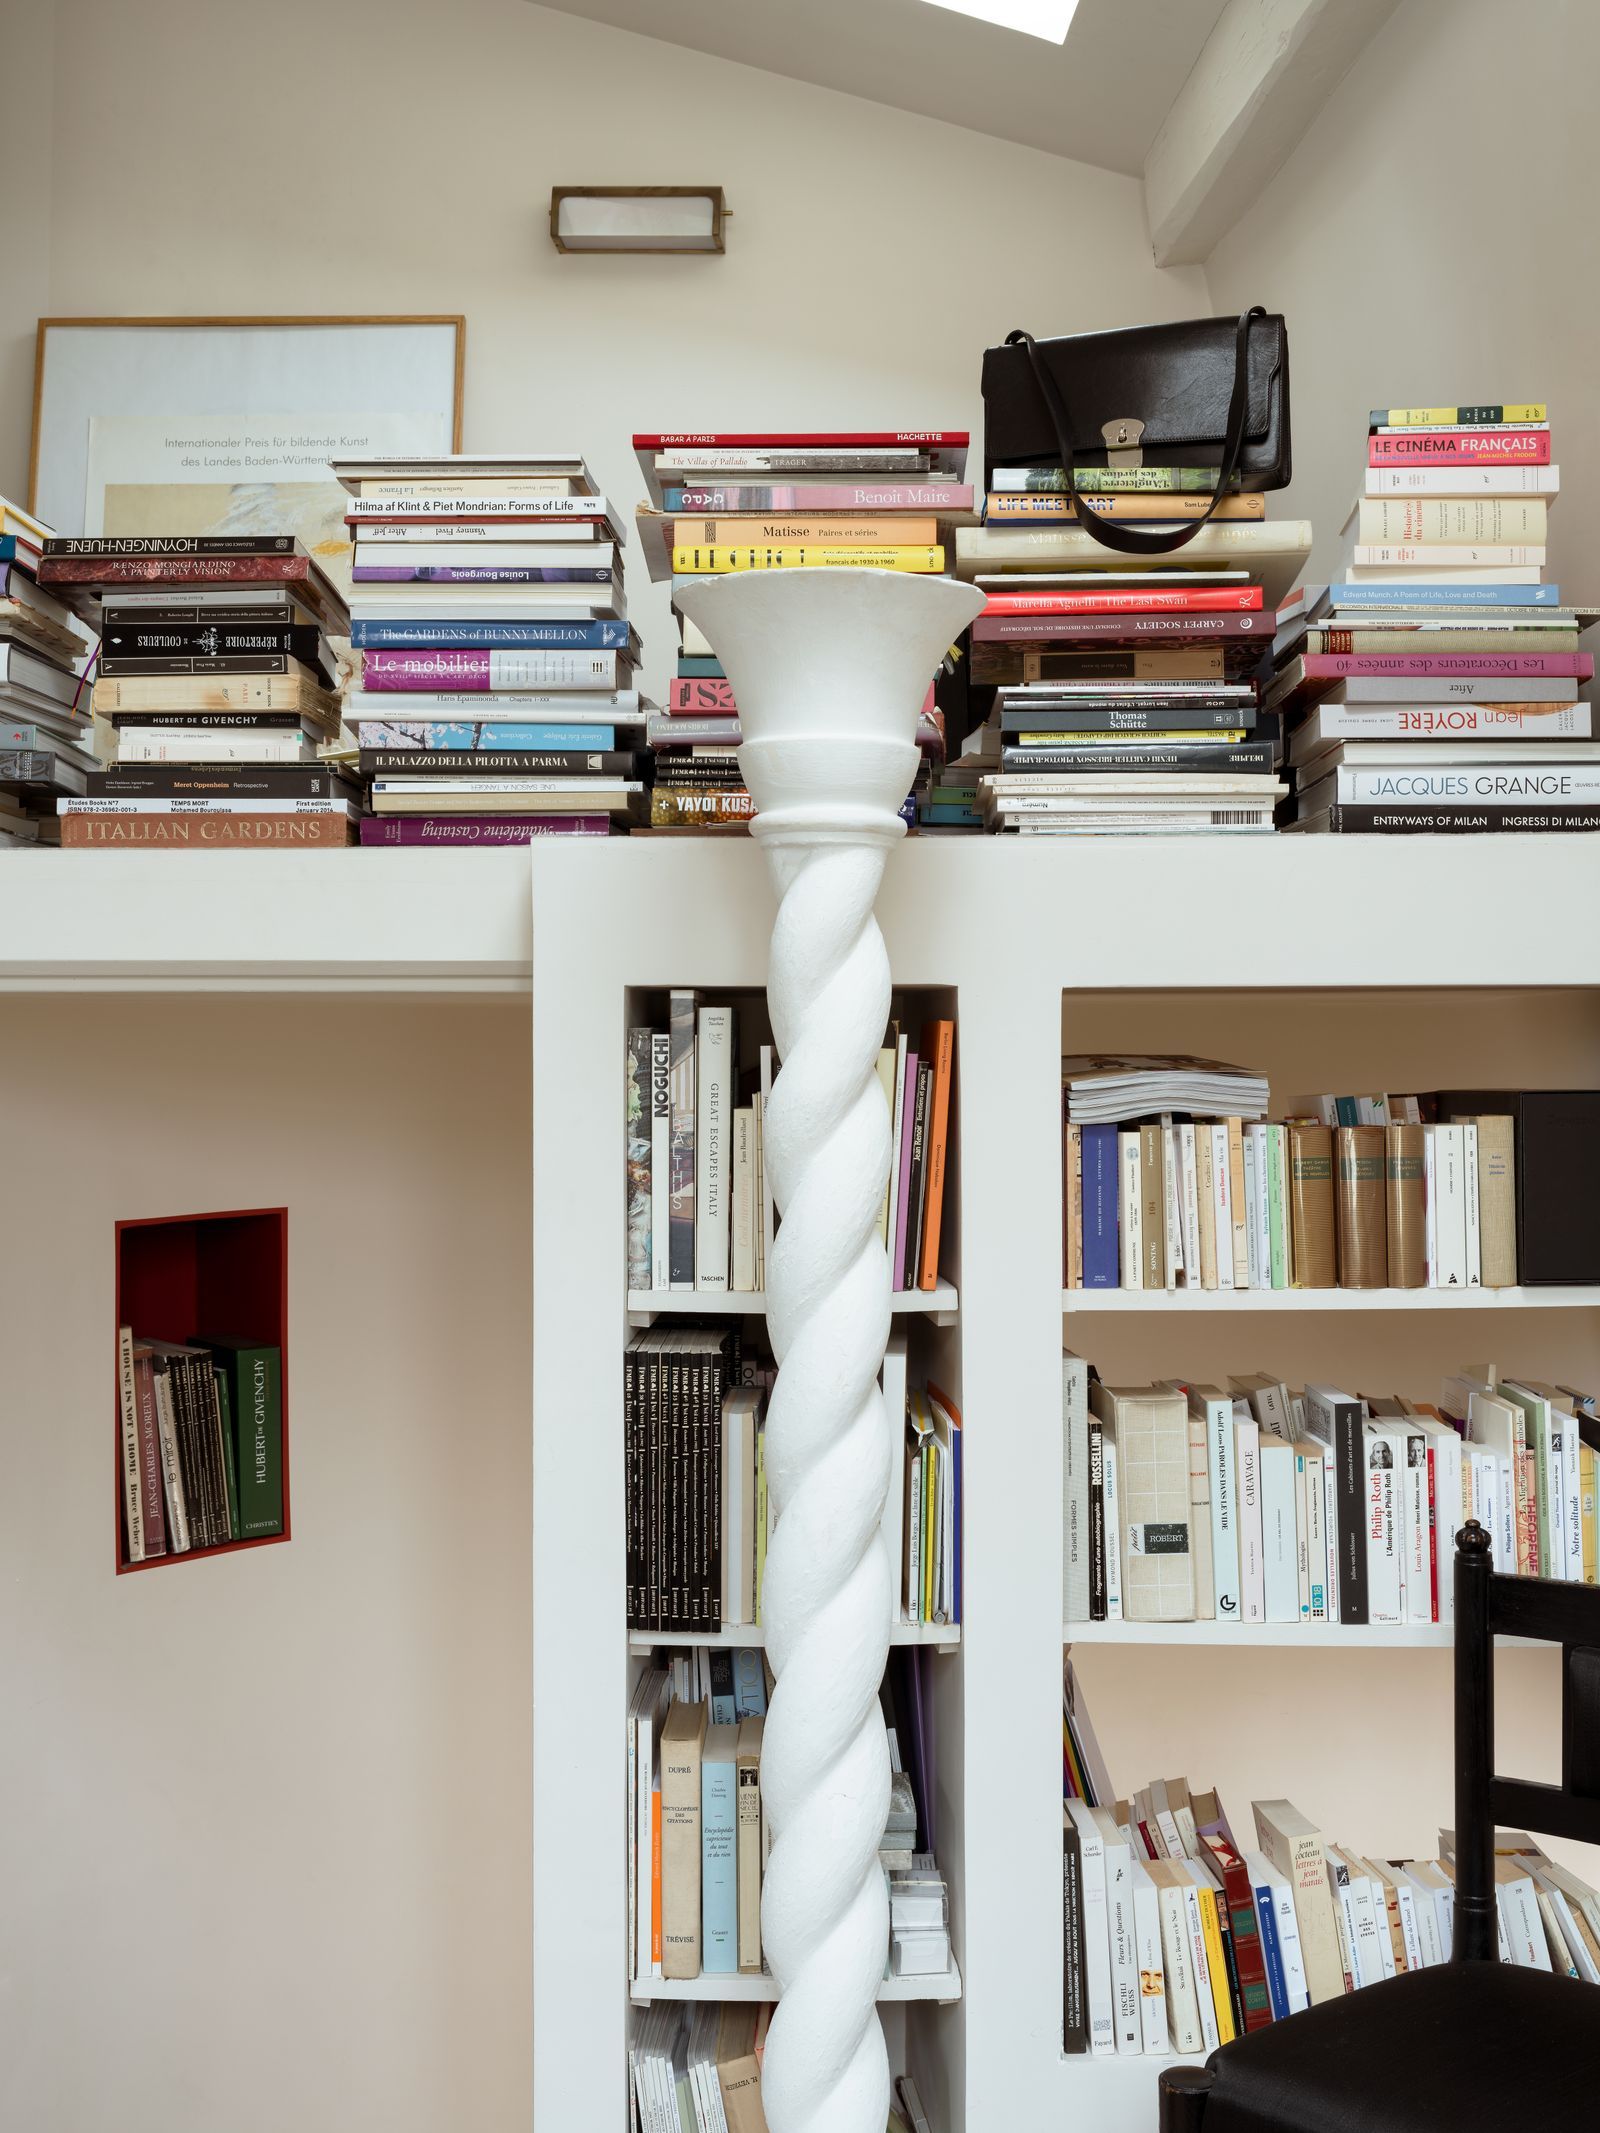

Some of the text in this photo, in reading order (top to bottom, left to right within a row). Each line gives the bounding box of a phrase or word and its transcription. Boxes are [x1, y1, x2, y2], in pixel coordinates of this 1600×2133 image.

[165, 435, 369, 449] Internationaler Preis für bildende Kunst
[660, 434, 716, 444] BABAR PARIS
[896, 432, 943, 442] HACHETTE
[1375, 436, 1537, 454] LE CINÉMA FRANÇAIS
[181, 456, 241, 467] des Landes
[1100, 469, 1138, 478] jardins
[854, 489, 951, 503] Benoît Maire
[353, 499, 575, 512] Hilma af Klint & Piet Mondrian: Forms of Life
[997, 497, 1116, 511] LIFE ART
[1184, 500, 1196, 509] Sam
[388, 527, 454, 537] Fivel After
[763, 525, 879, 539] Matisse Paires et séries
[65, 538, 199, 554] HOYNINGEN-HUENE
[111, 559, 237, 571] RENZO MONGIARDINO
[826, 558, 896, 567] français de 1930 1960
[129, 566, 232, 577] PAINTERLY VISION
[450, 569, 530, 581] Louise Bourgeois
[1012, 594, 1189, 612] Marella Agnelli The Last Swan
[1054, 619, 1225, 632] CARPET SOCIETY HISTOIRE
[398, 626, 588, 641] GARDENS of BUNNY MELLON
[137, 635, 279, 652] RÉPERTOIRE COULEURS
[373, 654, 397, 673] Le
[404, 653, 490, 673] mobilier
[1335, 658, 1546, 673] Les Décorateurs des années 40
[1448, 683, 1475, 695] After
[152, 717, 185, 726] HUBERT
[201, 715, 259, 726] GIVENCHY
[1108, 711, 1148, 720] Thomas
[1397, 707, 1524, 734] Jean ROYÈRE
[1109, 719, 1148, 729] Schütte
[375, 755, 568, 768] IL PALAZZO DELLA PILOTTA A PARMA
[1012, 755, 1178, 766] HENRI PHOTOGRAPHE
[1229, 753, 1264, 763] DELPIRE
[173, 781, 269, 791] Meret Oppenheim Retrospective
[469, 783, 537, 792] SAISON TANGER
[1369, 775, 1573, 797] JACQUES GRANGE
[170, 799, 209, 807] TEMPS MORT
[676, 796, 717, 812] YAYOI
[1373, 815, 1563, 827] ENTRYWAYS OF MILAN INGRESSI DI
[86, 821, 321, 841] ITALIAN GARDENS
[420, 821, 481, 841] Castaing
[653, 1037, 669, 1119] NOGUCHI
[708, 1082, 720, 1218] GREAT ESCAPES ITALY
[1149, 1241, 1157, 1271] SONTAG
[253, 1358, 267, 1485] HUBERT GIVENCHY
[123, 1347, 142, 1547] HOUSE IS NOT HOME Bruce Weber
[162, 1436, 175, 1467] miroir
[143, 1391, 161, 1519] JEAN-CHARLES MOREUX
[1091, 1432, 1103, 1486] ROSSELLINI
[1216, 1409, 1229, 1531] Adolf PAROLES DANS LE VIDE
[1244, 1450, 1256, 1506] CARAVAGE
[1370, 1472, 1386, 1540] Philip Roth
[1384, 1472, 1395, 1557] L'Amérique de Philip Roth
[1568, 1495, 1582, 1558] Notre solitude
[1149, 1533, 1184, 1544] ROBERT
[1414, 1525, 1423, 1551] Aragon
[1300, 1541, 1308, 1573] Mythologies
[1095, 1564, 1103, 1597] Fragments
[667, 1765, 693, 1775] DUPRÉ
[665, 1934, 696, 1944] TRÉVISE
[1114, 1901, 1126, 1966] Fleurs Questions
[1120, 1982, 1129, 2017] FISCHLI
[1128, 1989, 1136, 2017] WEISS
